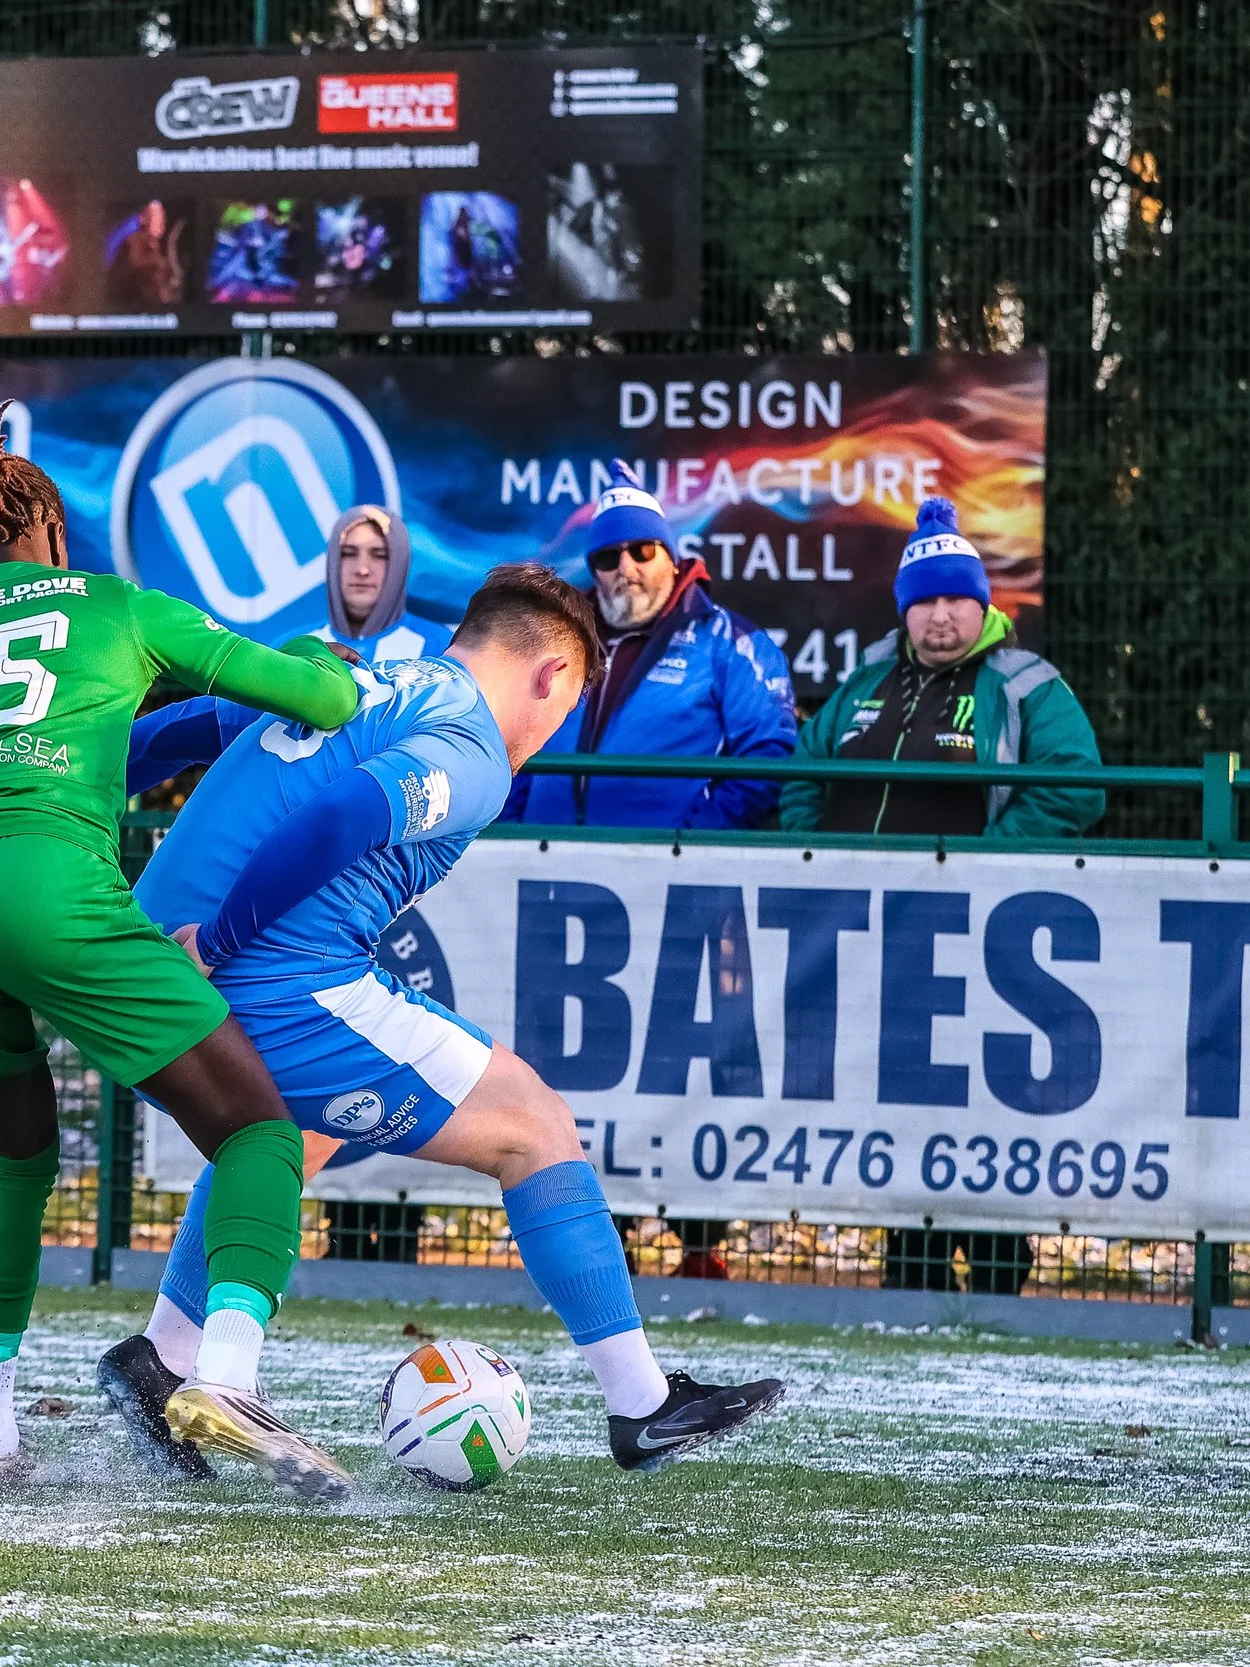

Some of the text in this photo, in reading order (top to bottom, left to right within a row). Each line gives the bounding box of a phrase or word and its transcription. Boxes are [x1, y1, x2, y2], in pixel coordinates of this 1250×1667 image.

[162, 82, 293, 132] CREW
[321, 83, 455, 109] QUEENS
[368, 107, 454, 128] HALL
[619, 381, 842, 429] DESIGN
[501, 458, 944, 505] MANUFACTURE
[677, 534, 854, 582] STALL
[12, 577, 87, 597] DOVE
[26, 588, 90, 601] PAGNELL
[17, 754, 69, 777] COMPANY
[405, 779, 419, 823] COURIERS
[408, 771, 424, 802] CROSS
[517, 879, 1102, 1116] BATES
[387, 1093, 420, 1128] ADVICE
[375, 1115, 418, 1146] SERVICES
[692, 1123, 896, 1190] 02476
[920, 1134, 1170, 1201] 638695
